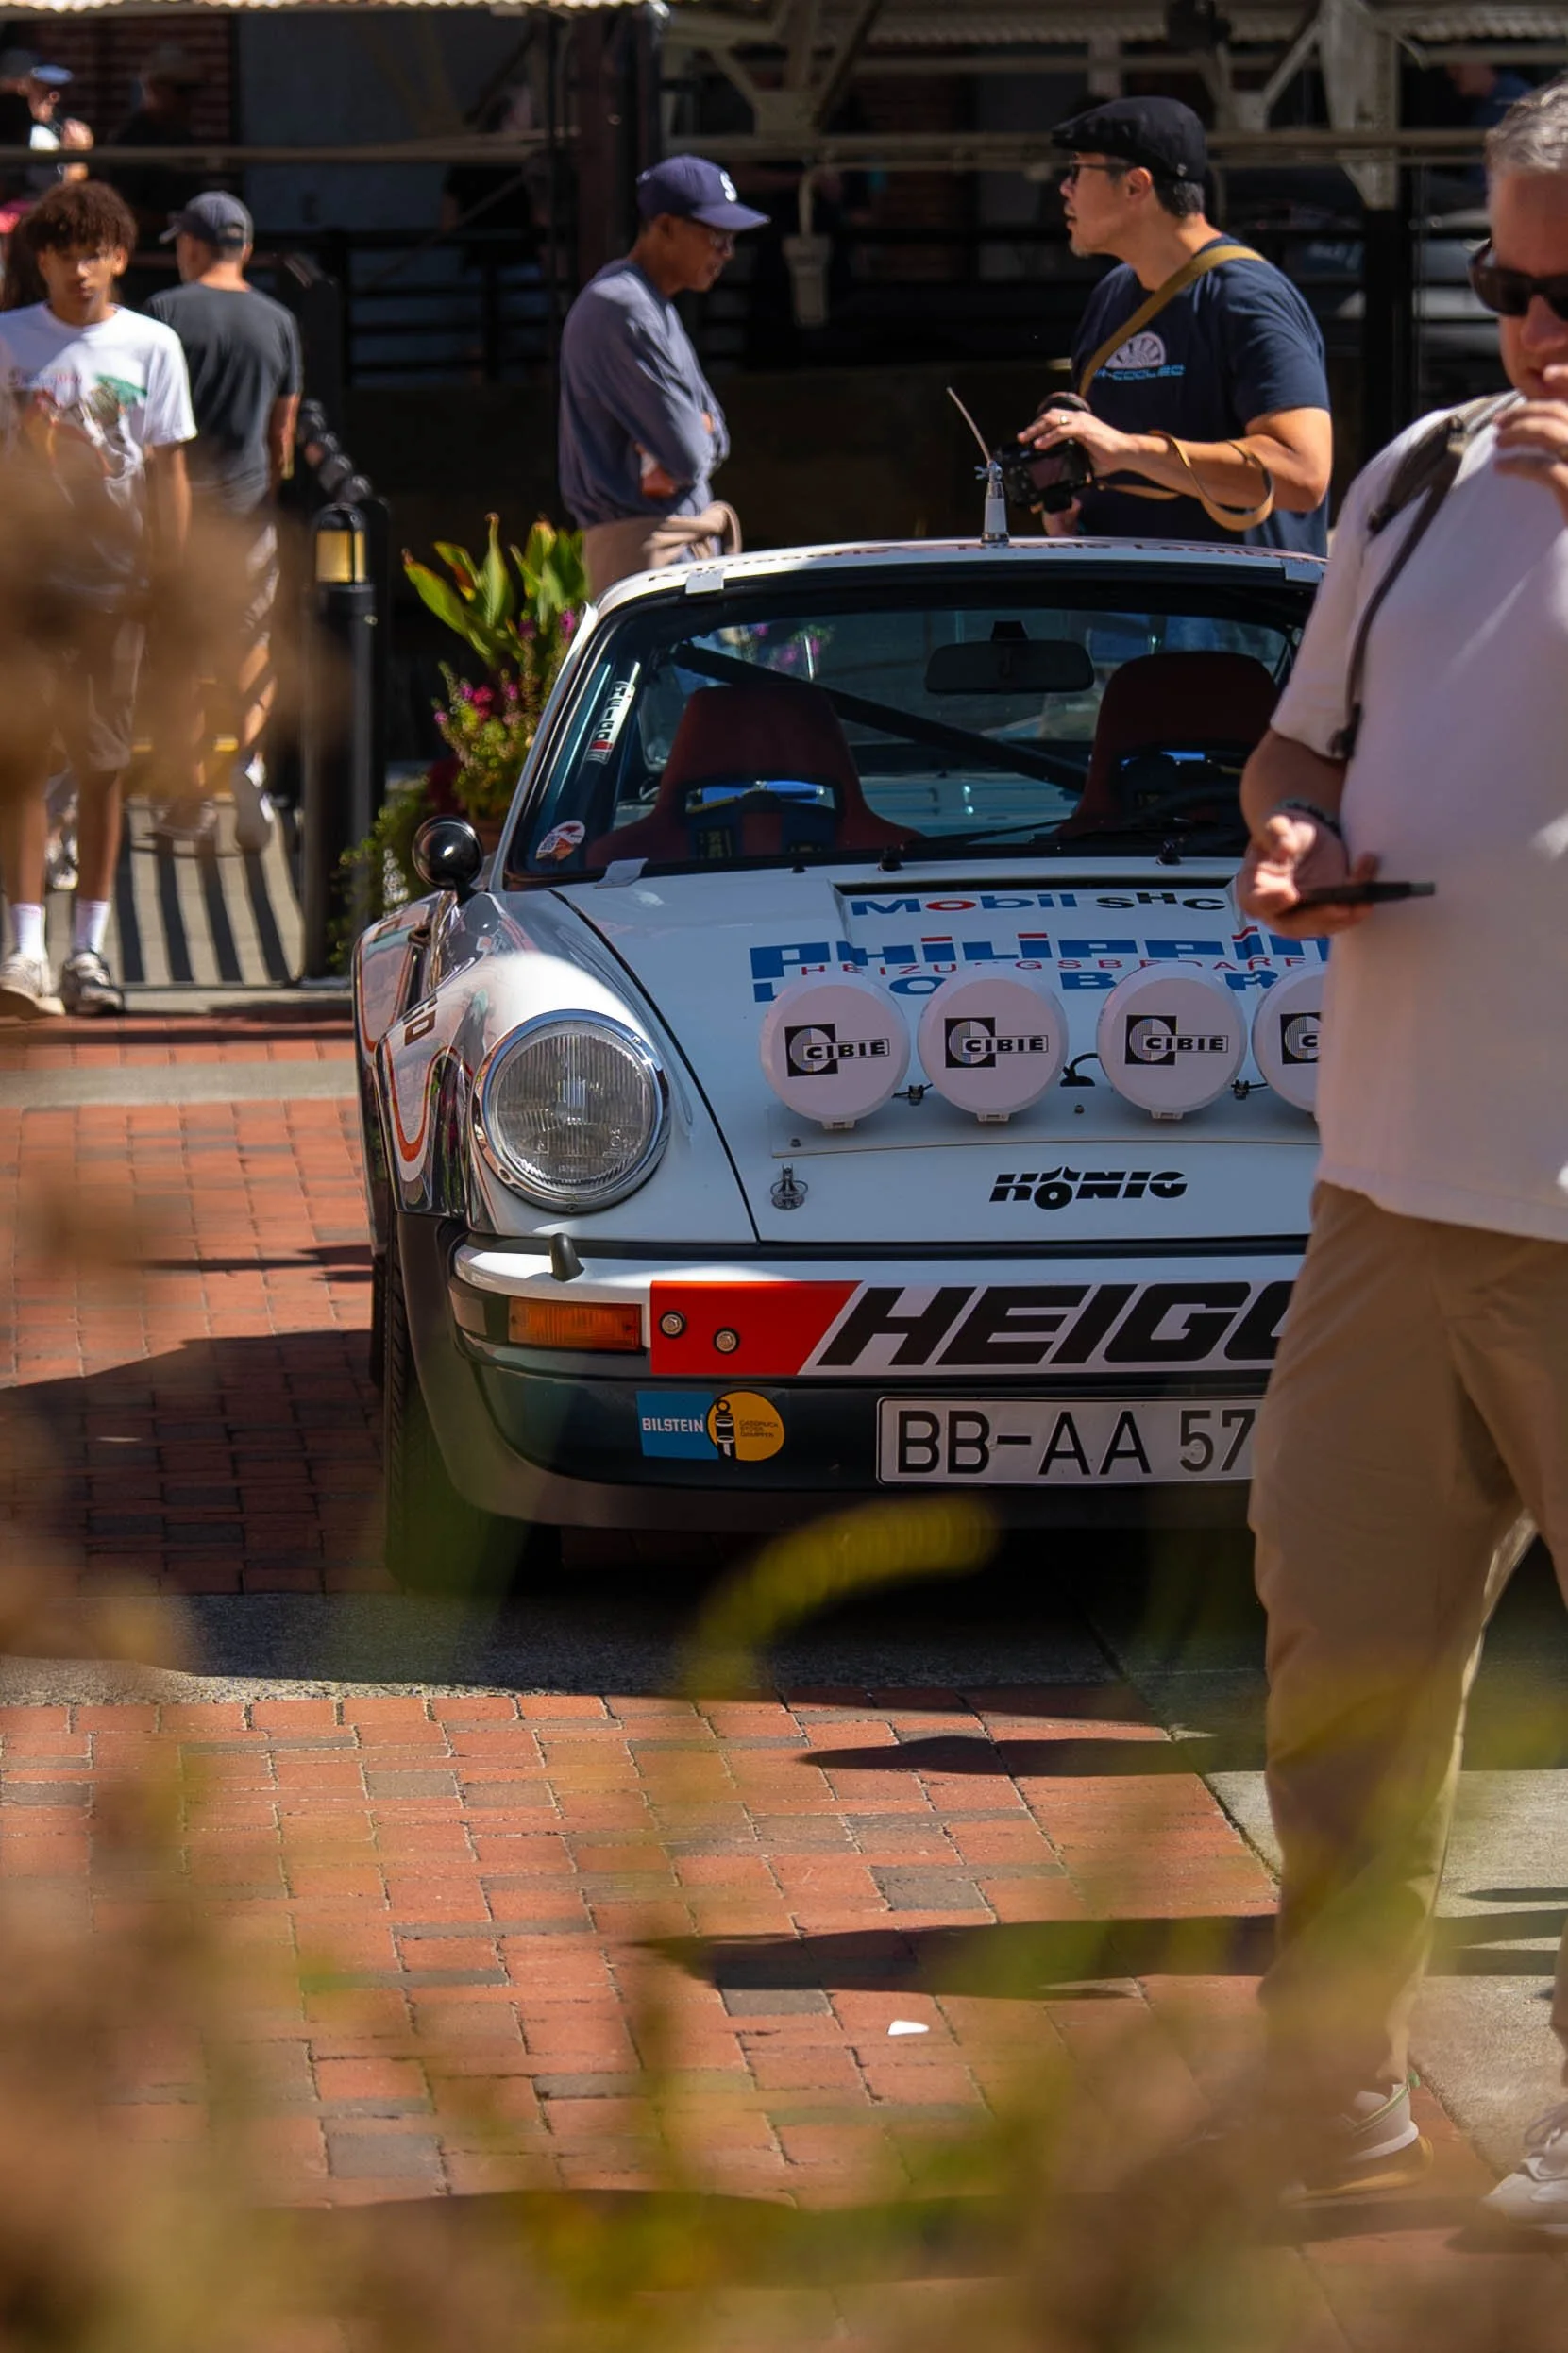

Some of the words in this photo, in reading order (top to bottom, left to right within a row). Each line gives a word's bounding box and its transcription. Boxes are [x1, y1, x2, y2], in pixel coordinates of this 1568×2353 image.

[851, 894, 1078, 916] Mobil
[1095, 892, 1226, 911] SHC
[642, 1417, 705, 1433] BILSTEIN
[897, 1409, 1152, 1475] BB-AA
